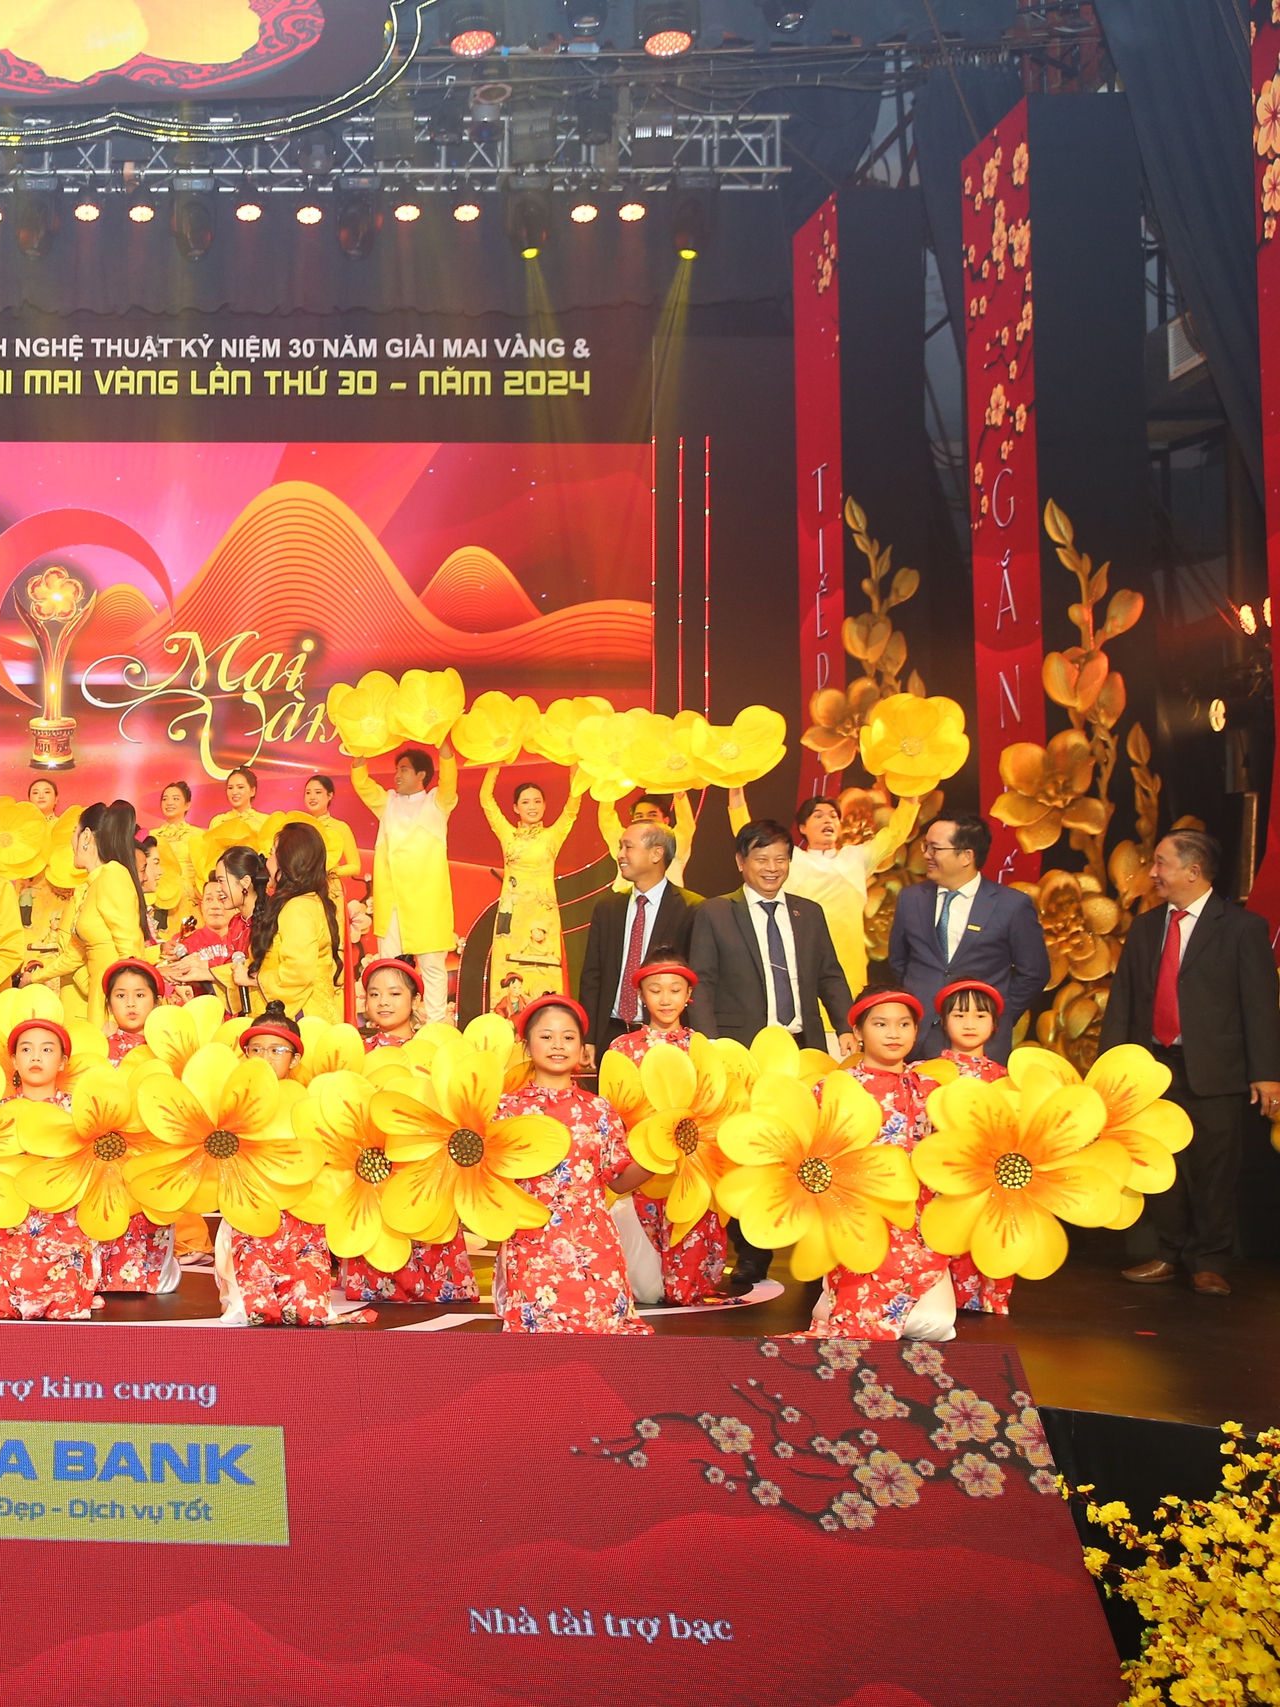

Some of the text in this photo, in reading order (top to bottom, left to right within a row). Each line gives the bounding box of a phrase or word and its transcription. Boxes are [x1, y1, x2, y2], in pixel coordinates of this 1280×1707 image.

[15, 334, 83, 362] NGHỆ
[91, 335, 173, 362] THUẬT
[181, 333, 214, 358] KỶ
[221, 334, 281, 363] NIỆM
[288, 338, 315, 358] 30
[323, 334, 378, 358] NĂM
[385, 333, 435, 358] GIẢI
[443, 338, 487, 358] MAI
[494, 333, 565, 358] VÀNG
[572, 338, 591, 358] &
[24, 369, 81, 395] MAI
[94, 365, 179, 395] VÀNG
[190, 361, 251, 395] LẦN
[263, 365, 328, 395] THỨ
[337, 370, 378, 396] 30
[418, 365, 491, 396] NĂM
[503, 370, 591, 396] 2024
[992, 468, 1021, 729] GẮN
[42, 1374, 104, 1399] kim
[114, 1380, 217, 1408] cương
[53, 1440, 256, 1485] BANK
[68, 1498, 125, 1523] Dịch
[133, 1504, 164, 1524] vụ
[171, 1497, 213, 1522] Tốt
[468, 1606, 734, 1645] Nhà tài trợ bạc
